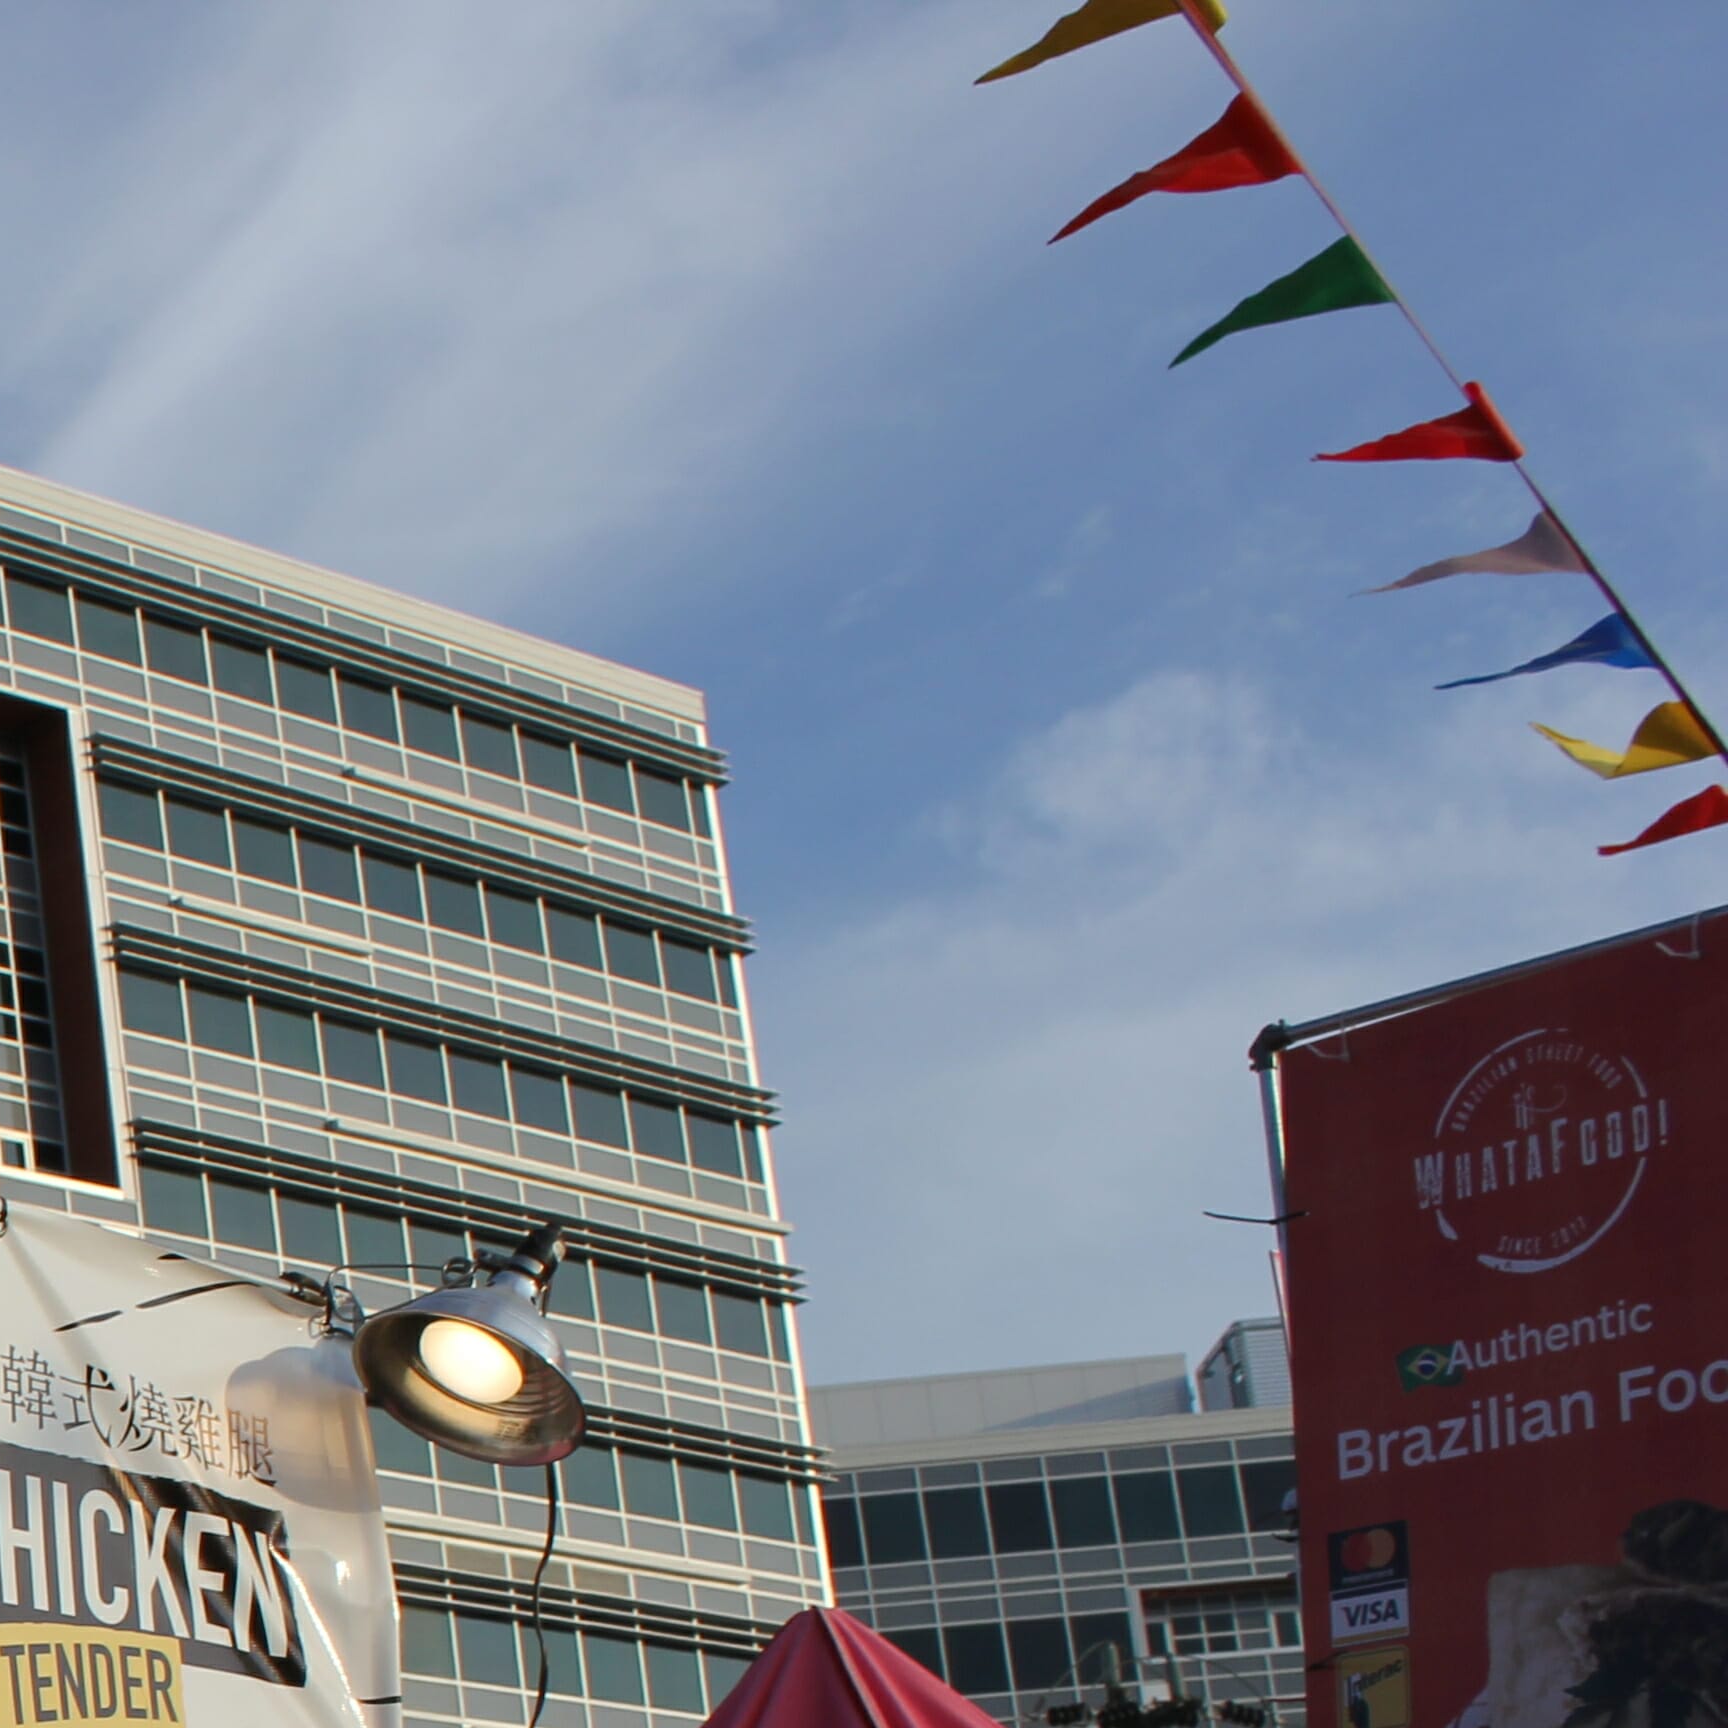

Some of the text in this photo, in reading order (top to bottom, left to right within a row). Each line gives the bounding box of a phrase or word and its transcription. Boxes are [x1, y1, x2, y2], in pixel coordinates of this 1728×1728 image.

[1445, 1300, 1654, 1374] Authentic
[1337, 1363, 1728, 1480] Brazilian Foo
[1341, 1598, 1401, 1627] VISA
[9, 1642, 181, 1726] TENDER
